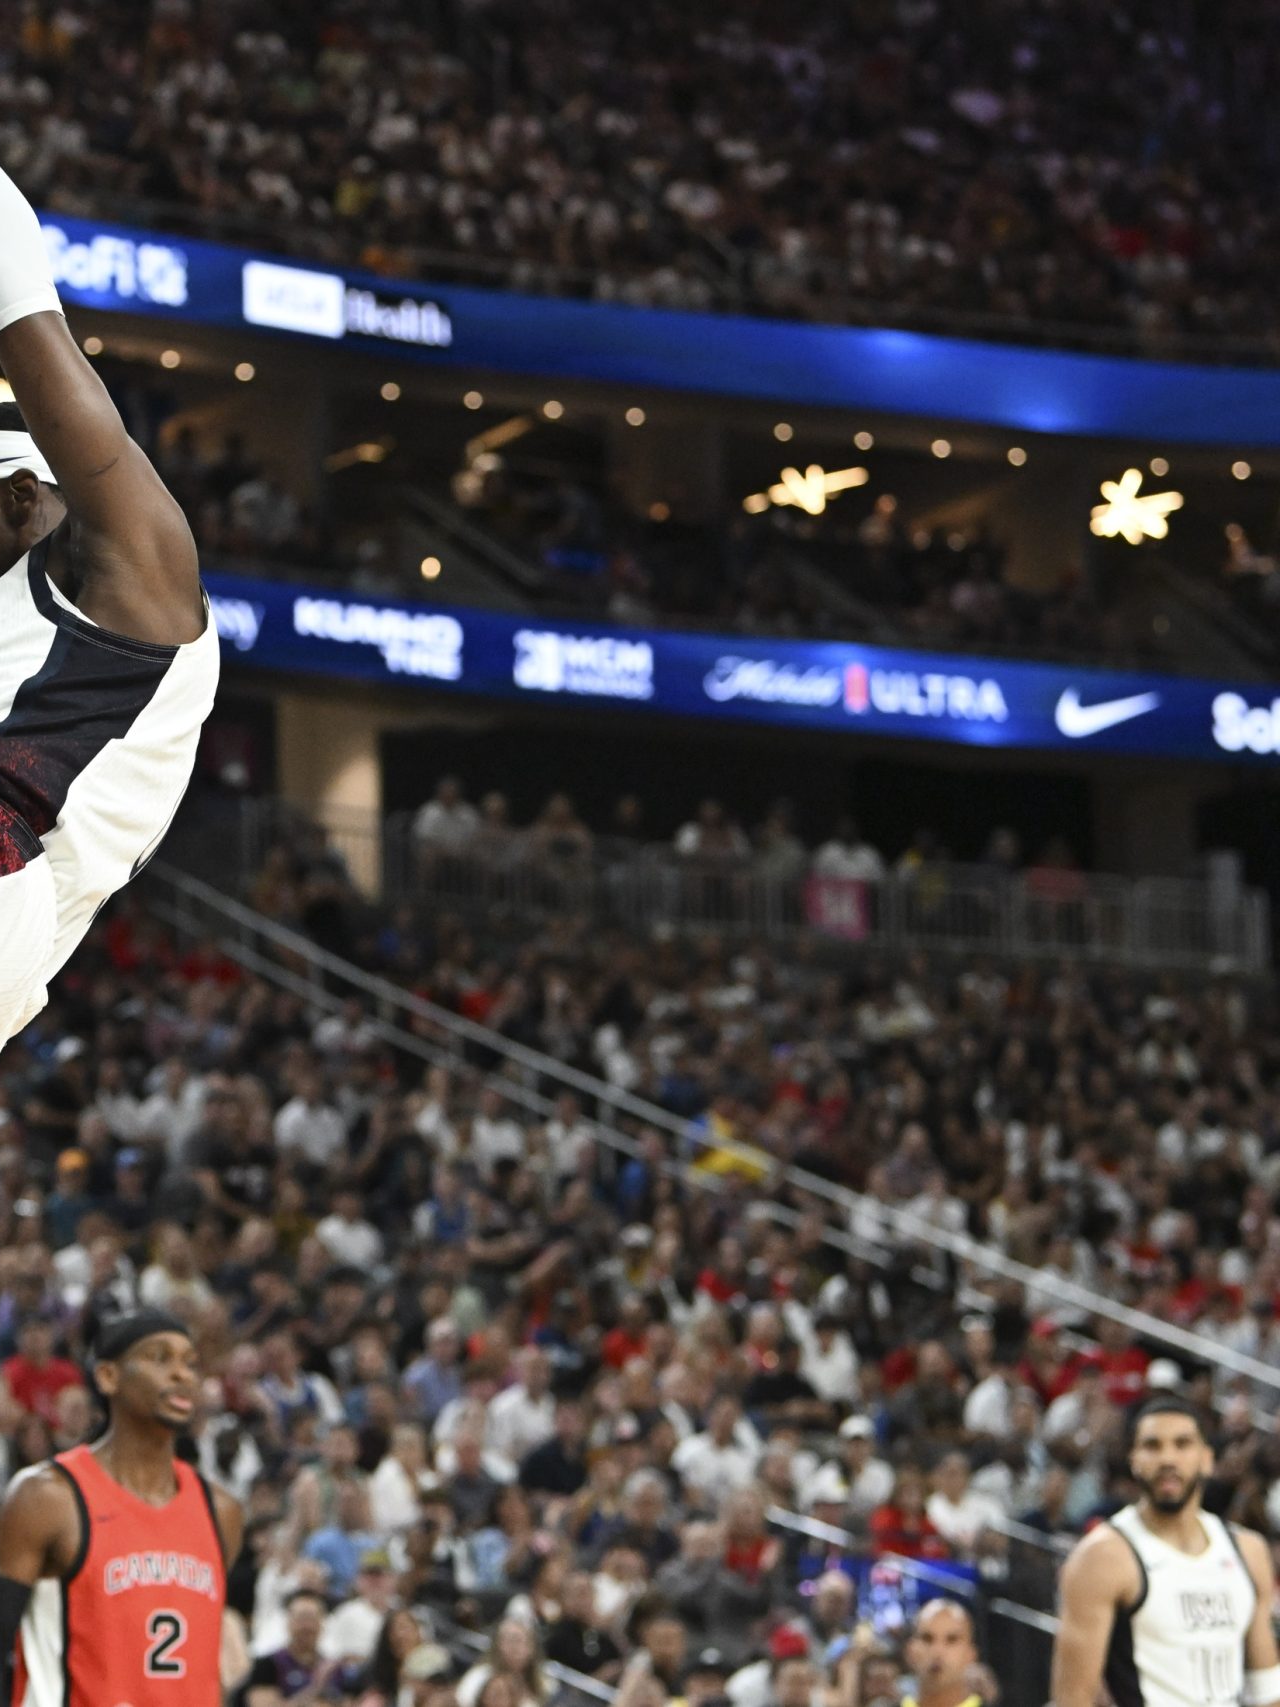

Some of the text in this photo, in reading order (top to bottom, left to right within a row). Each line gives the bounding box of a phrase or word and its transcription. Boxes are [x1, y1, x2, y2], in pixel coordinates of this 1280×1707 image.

[871, 669, 1009, 723] ULTRA
[105, 1551, 218, 1599] CANADA
[146, 1609, 185, 1677] 2
